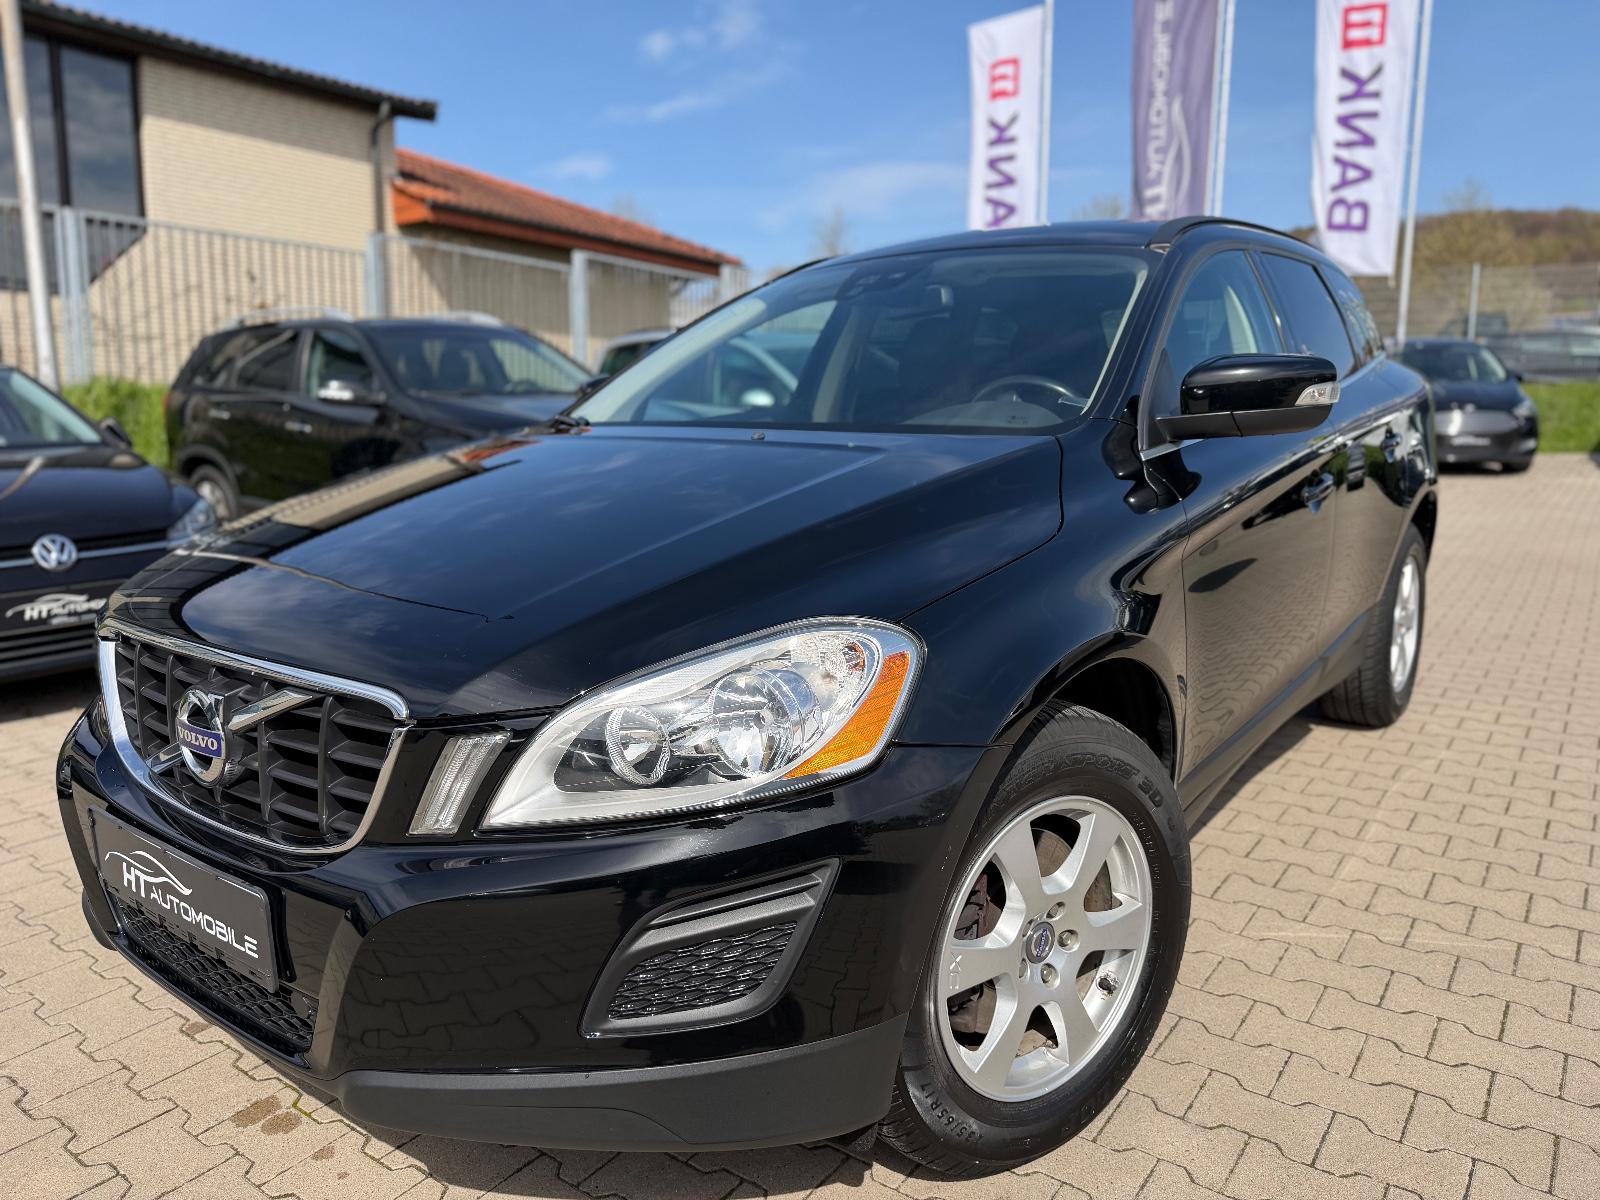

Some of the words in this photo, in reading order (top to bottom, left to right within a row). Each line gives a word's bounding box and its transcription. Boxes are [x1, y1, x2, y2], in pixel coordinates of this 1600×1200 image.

[177, 725, 218, 751] VOLVO
[122, 861, 146, 898] HT
[150, 885, 259, 959] AUTOMOBILE
